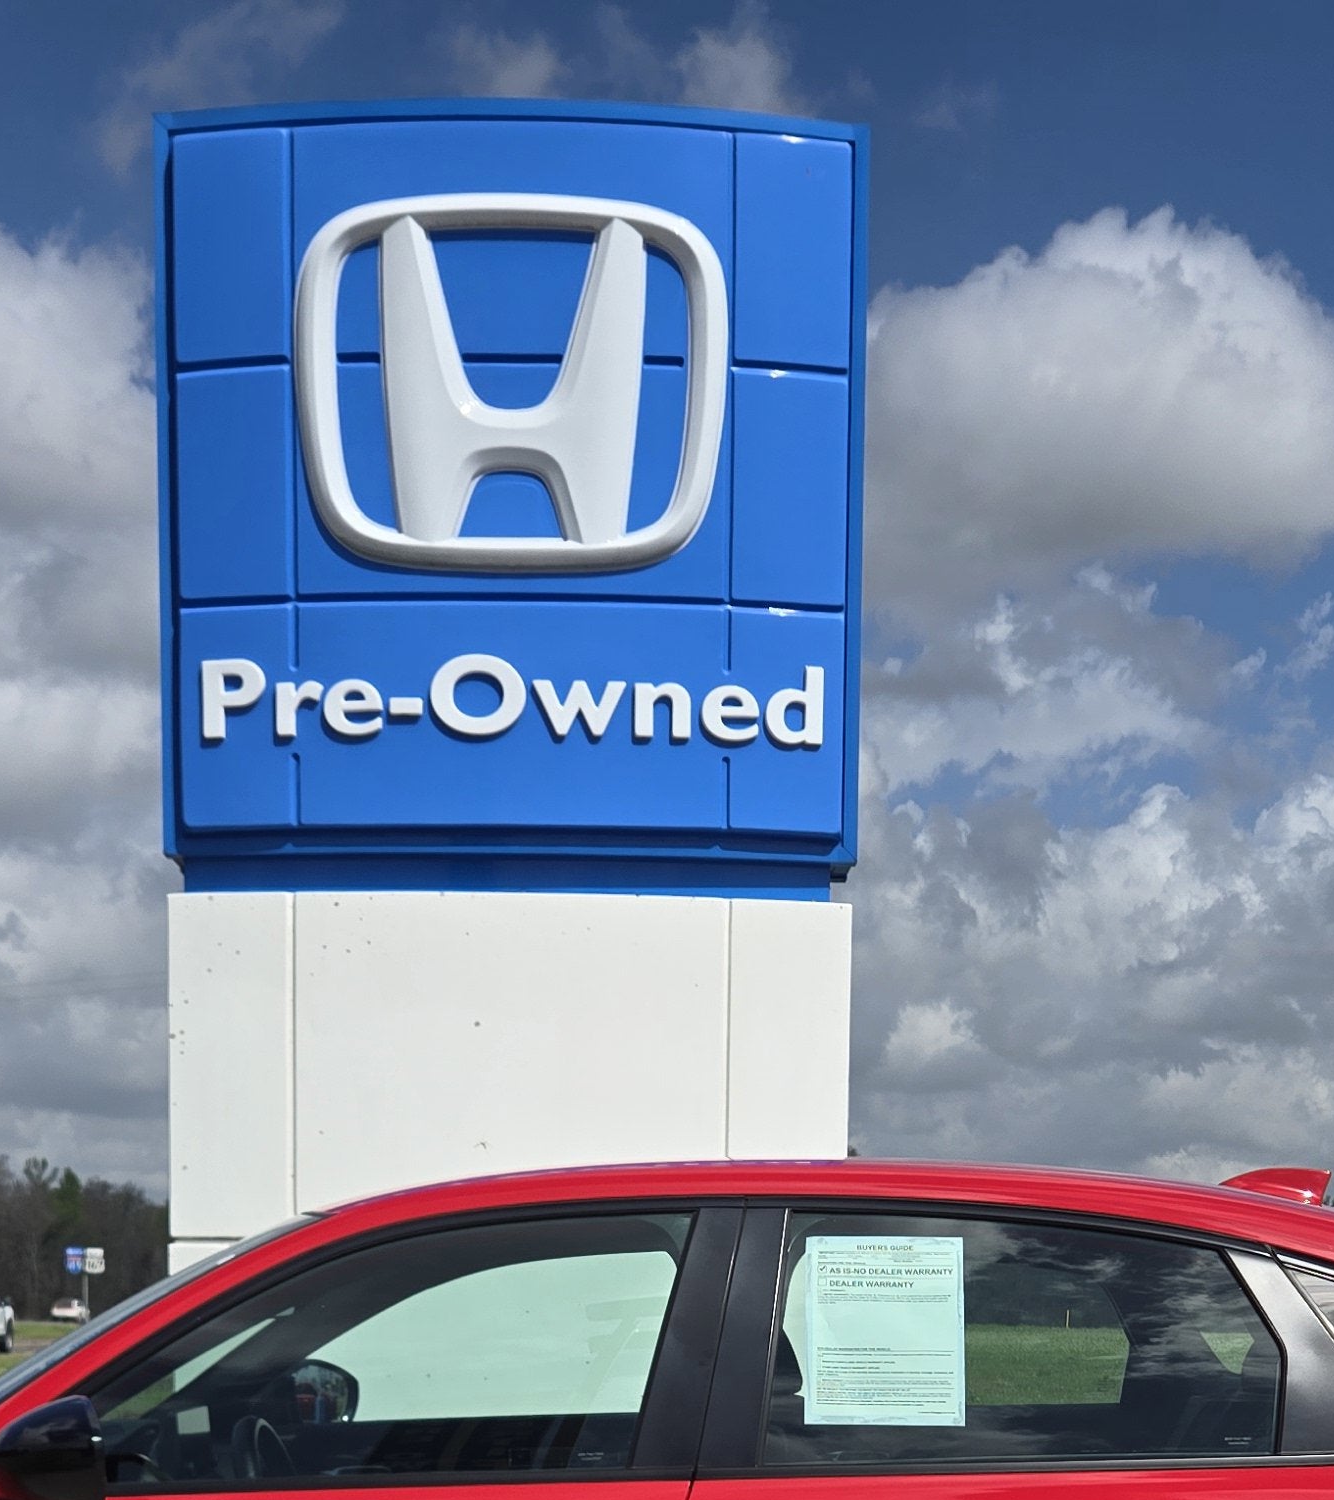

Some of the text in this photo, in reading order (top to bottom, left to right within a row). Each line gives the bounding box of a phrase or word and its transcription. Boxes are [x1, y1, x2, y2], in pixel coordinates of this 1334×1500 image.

[199, 653, 825, 746] Pre-Owned
[829, 1267, 841, 1275] AS
[868, 1268, 903, 1276] DEALER
[904, 1268, 954, 1276] WARRANTY
[829, 1279, 914, 1288] DEALER WARRANTY
